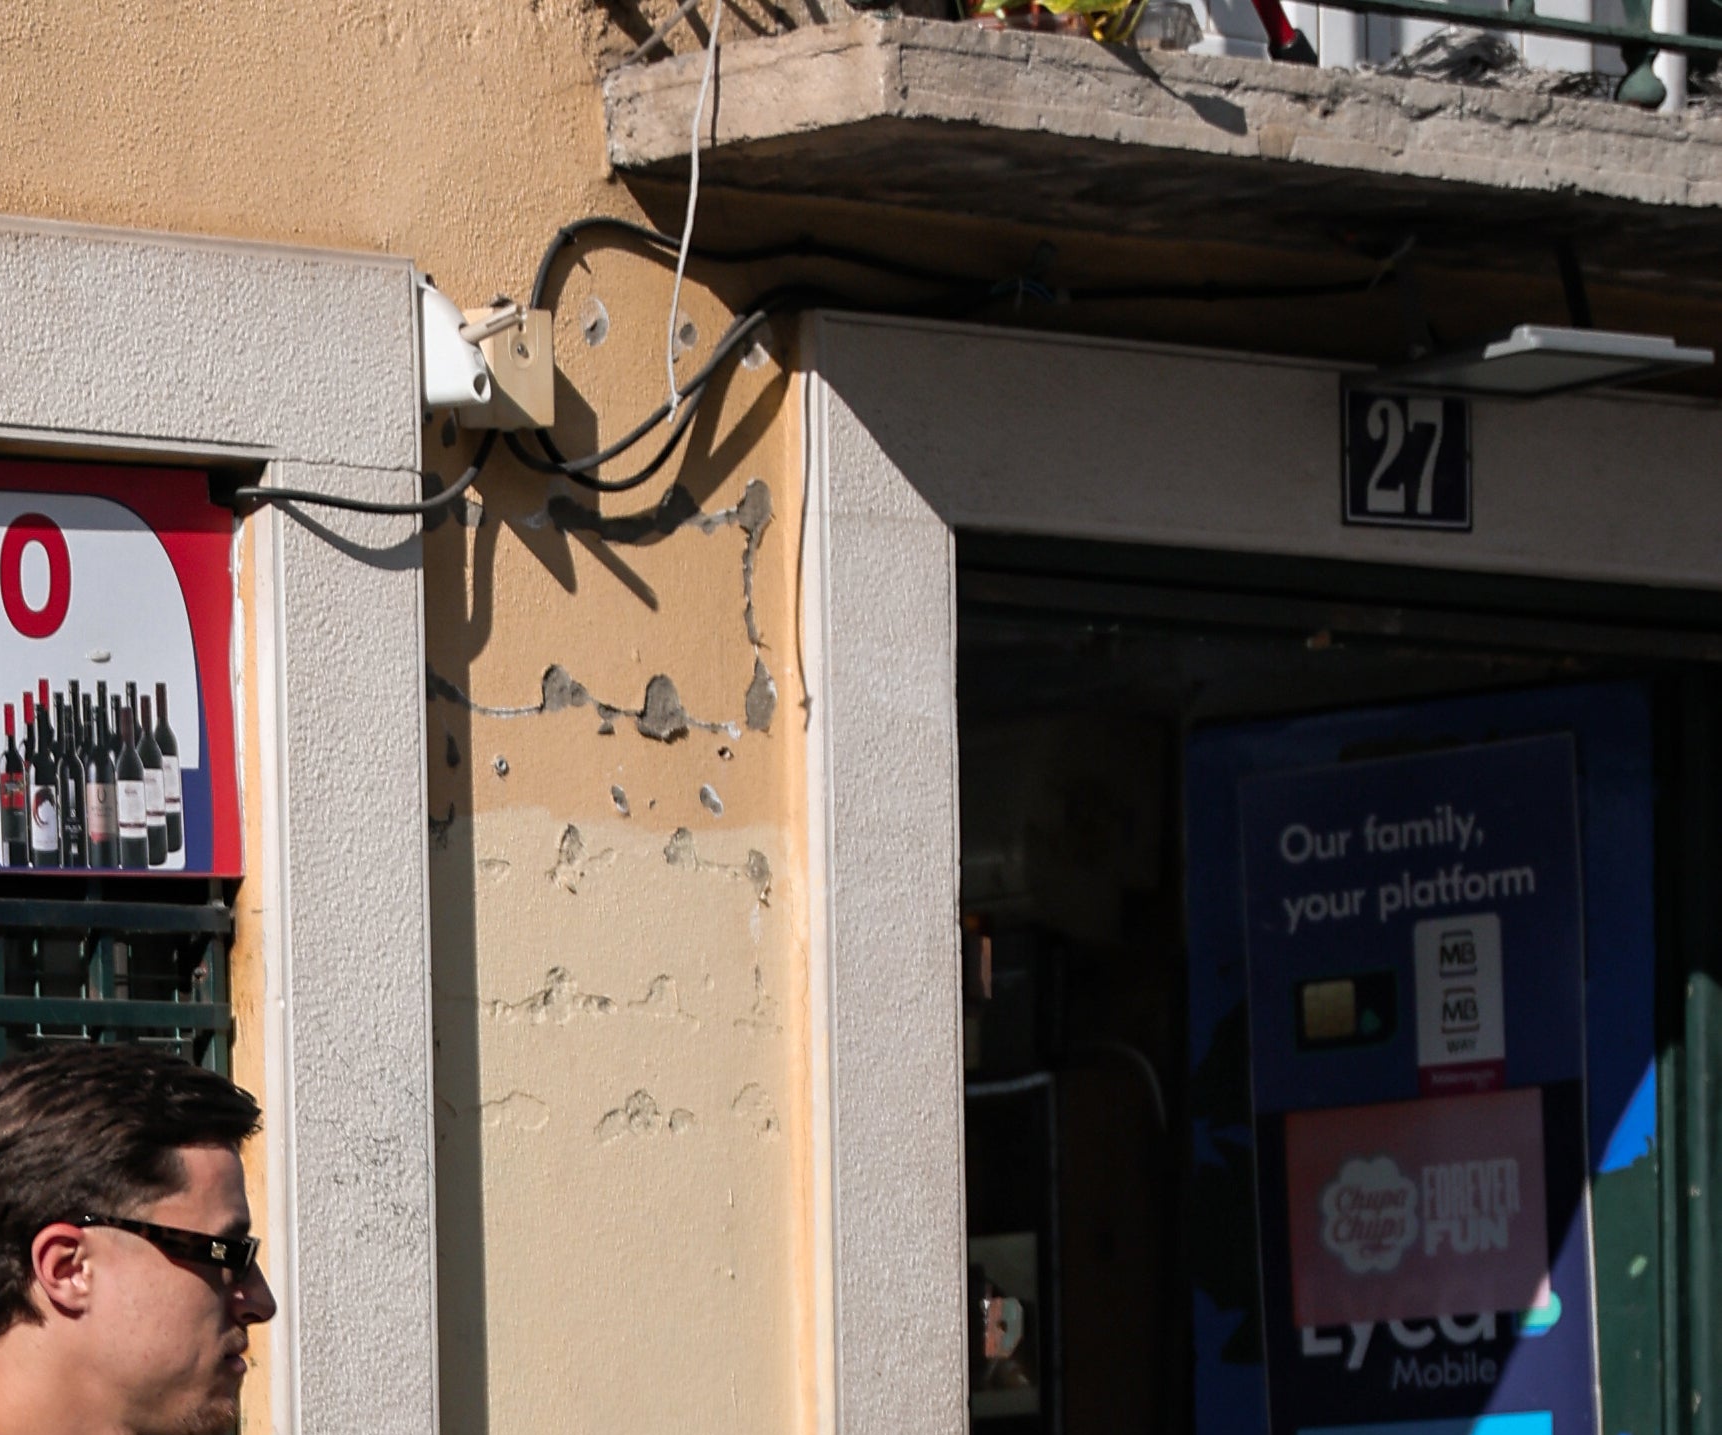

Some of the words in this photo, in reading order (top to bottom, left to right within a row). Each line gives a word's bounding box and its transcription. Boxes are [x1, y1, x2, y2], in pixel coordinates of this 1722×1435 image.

[1367, 399, 1444, 515] 27
[1280, 823, 1352, 864] Our
[1363, 804, 1485, 852] family,
[1283, 887, 1367, 936] your
[1379, 862, 1536, 924] platform
[1440, 942, 1476, 966] MB
[1442, 998, 1478, 1023] MB
[1422, 1158, 1521, 1221] FOREVER
[1424, 1213, 1509, 1257] FUN
[1391, 1351, 1499, 1392] Mobile
